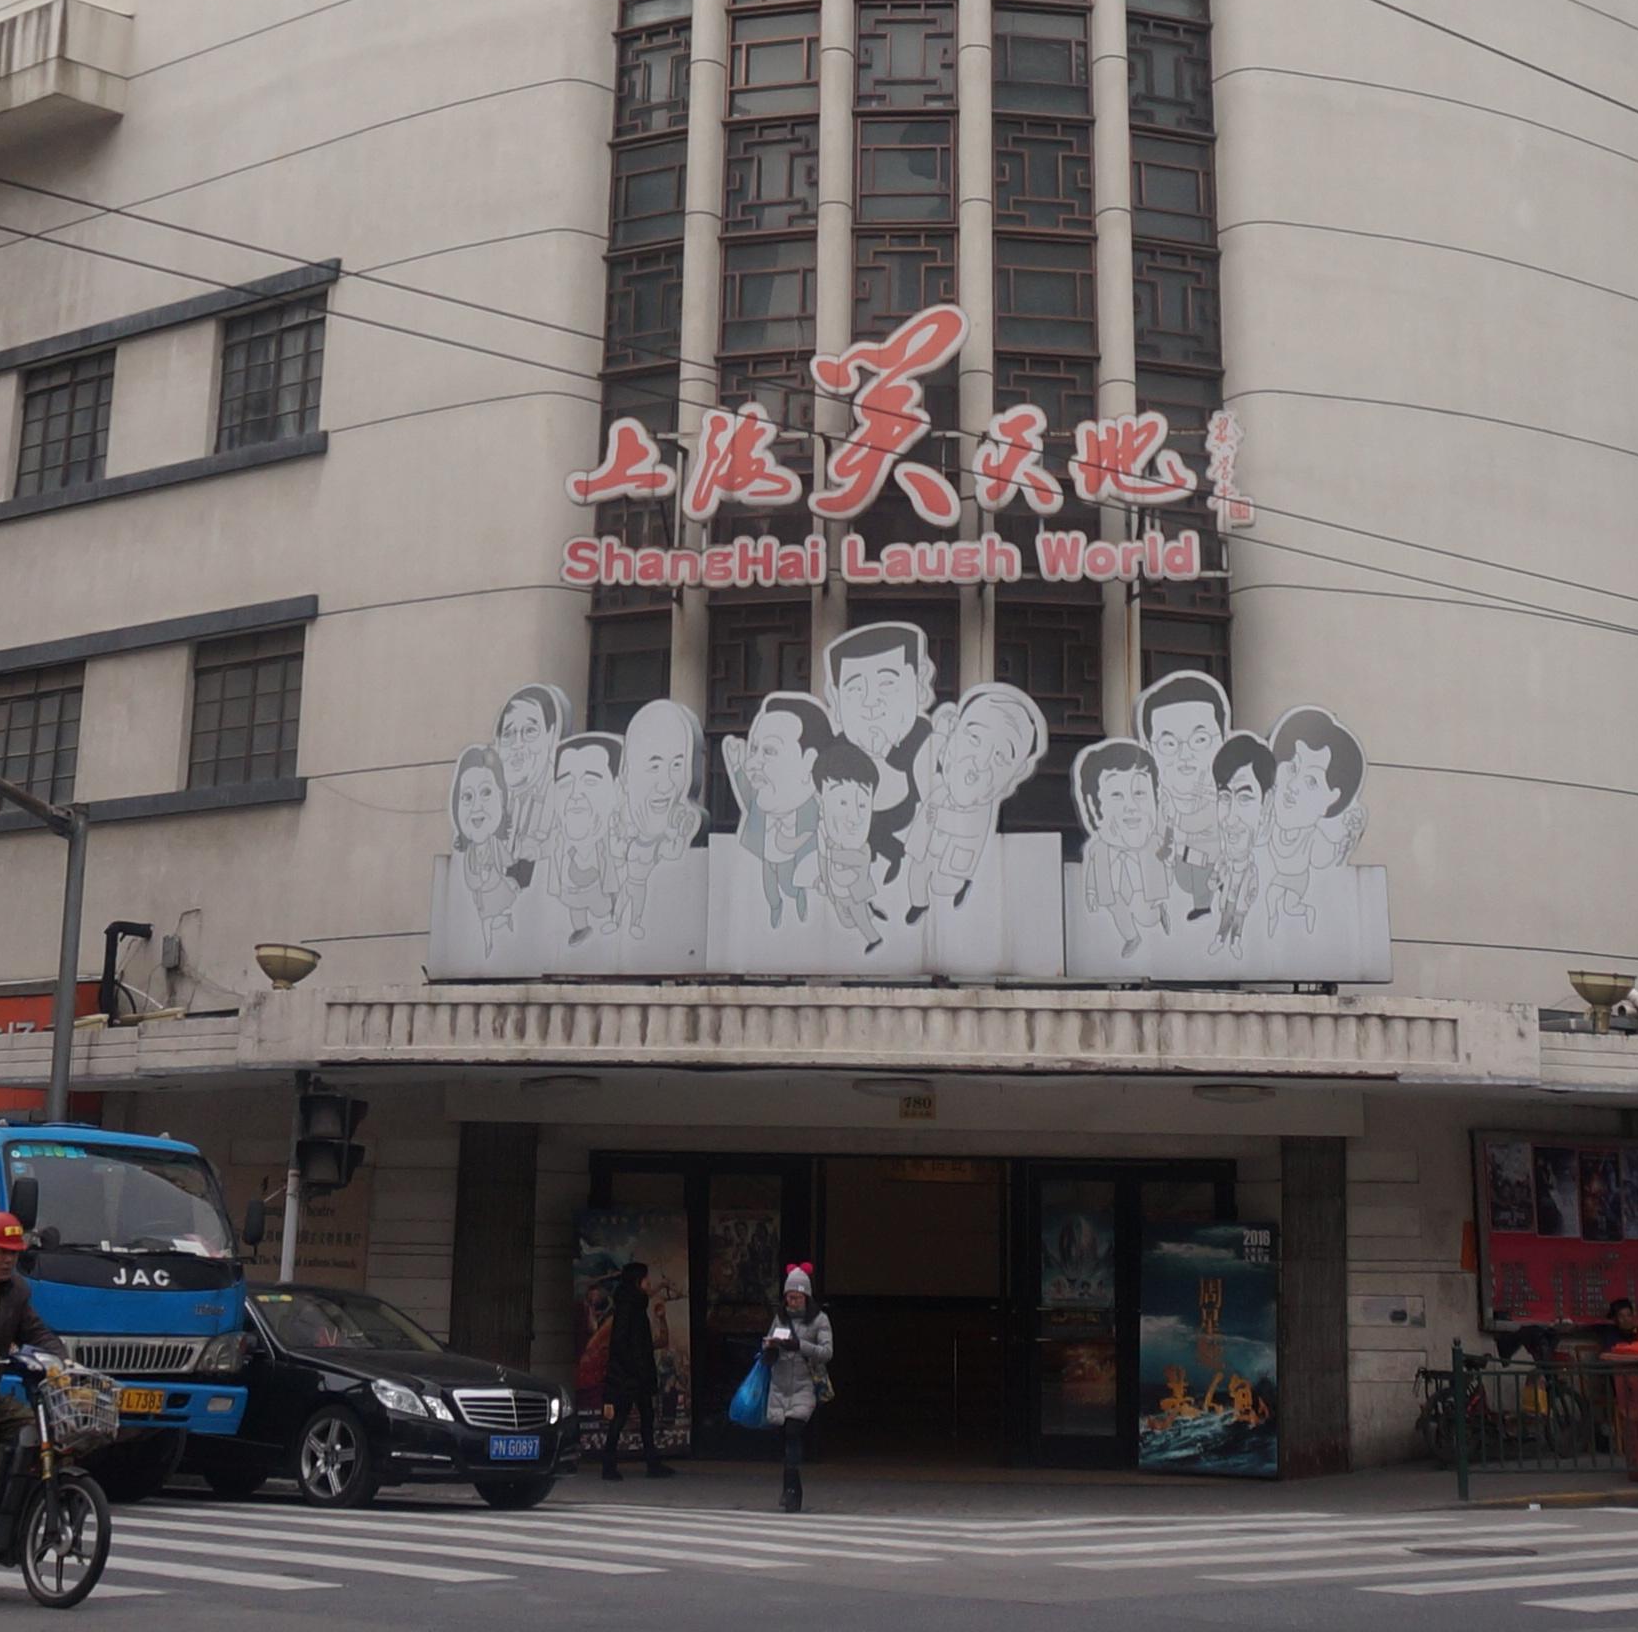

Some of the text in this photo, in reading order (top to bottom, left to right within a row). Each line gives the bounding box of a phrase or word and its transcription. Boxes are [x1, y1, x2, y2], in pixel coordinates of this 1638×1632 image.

[565, 532, 1199, 586] ShangHai Laugh World
[113, 1267, 171, 1287] JAC
